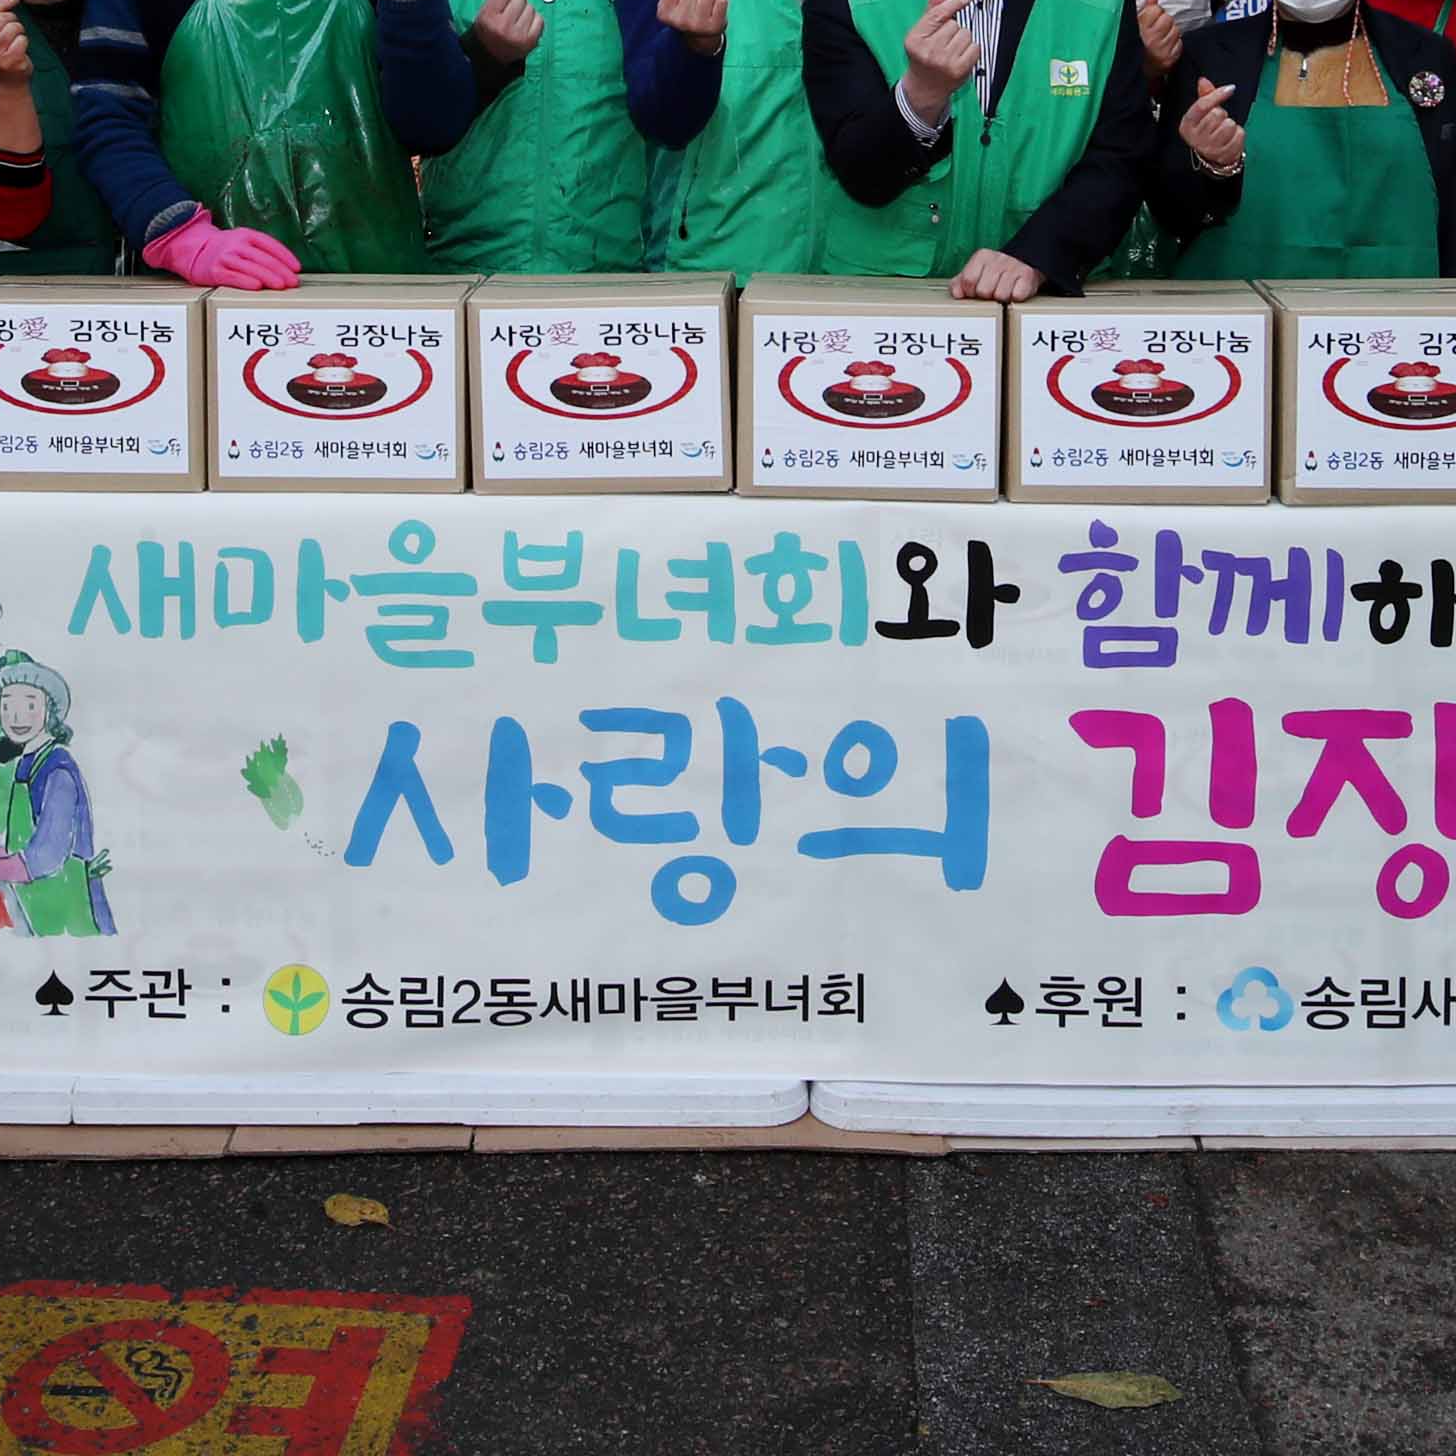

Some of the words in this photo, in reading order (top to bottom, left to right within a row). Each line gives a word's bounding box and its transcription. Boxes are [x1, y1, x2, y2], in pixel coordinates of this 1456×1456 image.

[69, 320, 175, 346] 김장나눔
[336, 324, 443, 347] 김장나눔
[599, 322, 707, 349] 김장나눔
[873, 332, 983, 358] 김장나눔
[1142, 330, 1252, 354] 김장나눔
[48, 435, 140, 454] 새마을부녀회
[249, 440, 304, 459] 송림2동
[314, 440, 407, 460] 새마을부녀회
[513, 441, 570, 461] 송림2동
[579, 440, 672, 460] 새마을부녀회
[1051, 448, 1109, 467] 송림2동
[1118, 446, 1214, 467] 새마을부녀회
[782, 449, 840, 468] 송림2동
[849, 450, 944, 469] 새마을부녀회
[1326, 451, 1384, 470] 송림2동
[68, 518, 1021, 669] 새마을부녀회와
[344, 696, 990, 926] 사랑의
[85, 968, 192, 1019] 주관
[341, 973, 866, 1030] 송림2동새마을부녀회
[1035, 975, 1144, 1029] 후원
